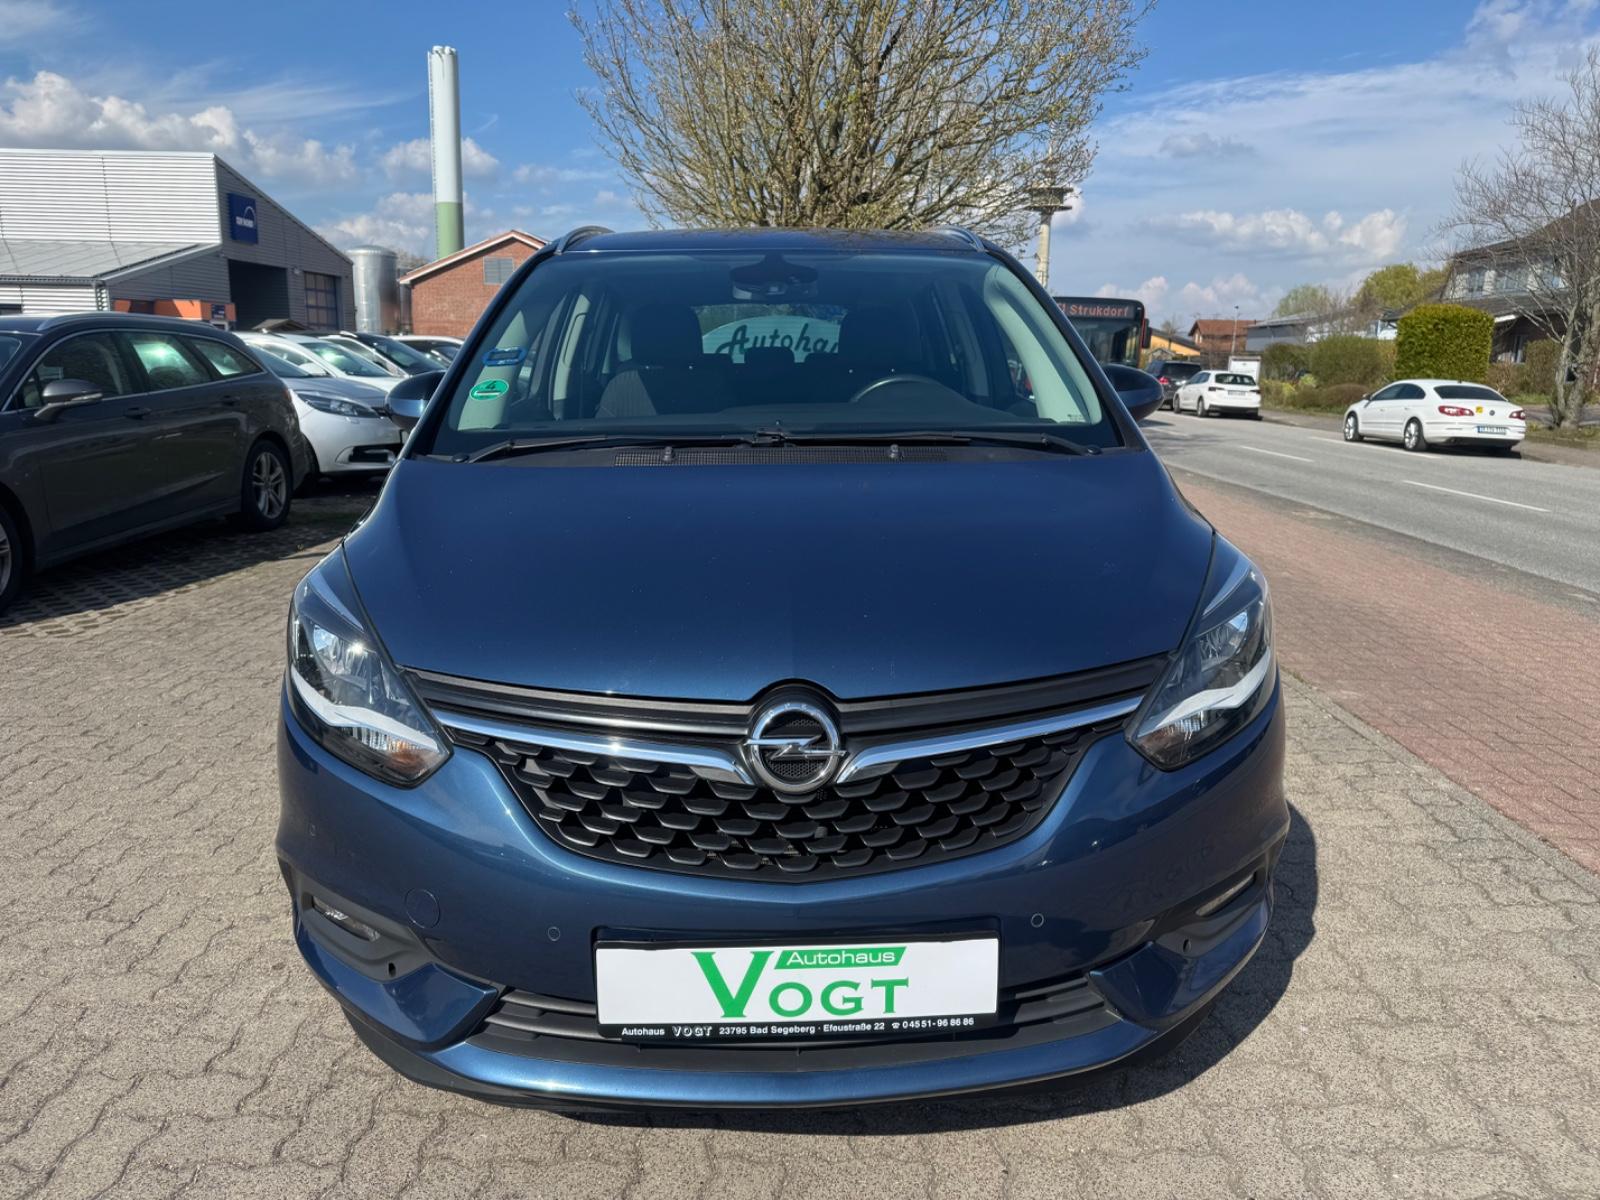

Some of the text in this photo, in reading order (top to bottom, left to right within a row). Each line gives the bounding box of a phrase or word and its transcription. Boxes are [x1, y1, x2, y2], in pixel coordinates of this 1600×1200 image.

[1070, 304, 1129, 317] Strukdorf
[786, 951, 896, 967] Autohaus
[621, 1027, 666, 1036] Autohaus
[672, 1026, 713, 1037] VOGT
[719, 1026, 747, 1035] 23795
[749, 1025, 769, 1034] Bad
[770, 1024, 816, 1034] Segeberg
[873, 1022, 885, 1031] 22
